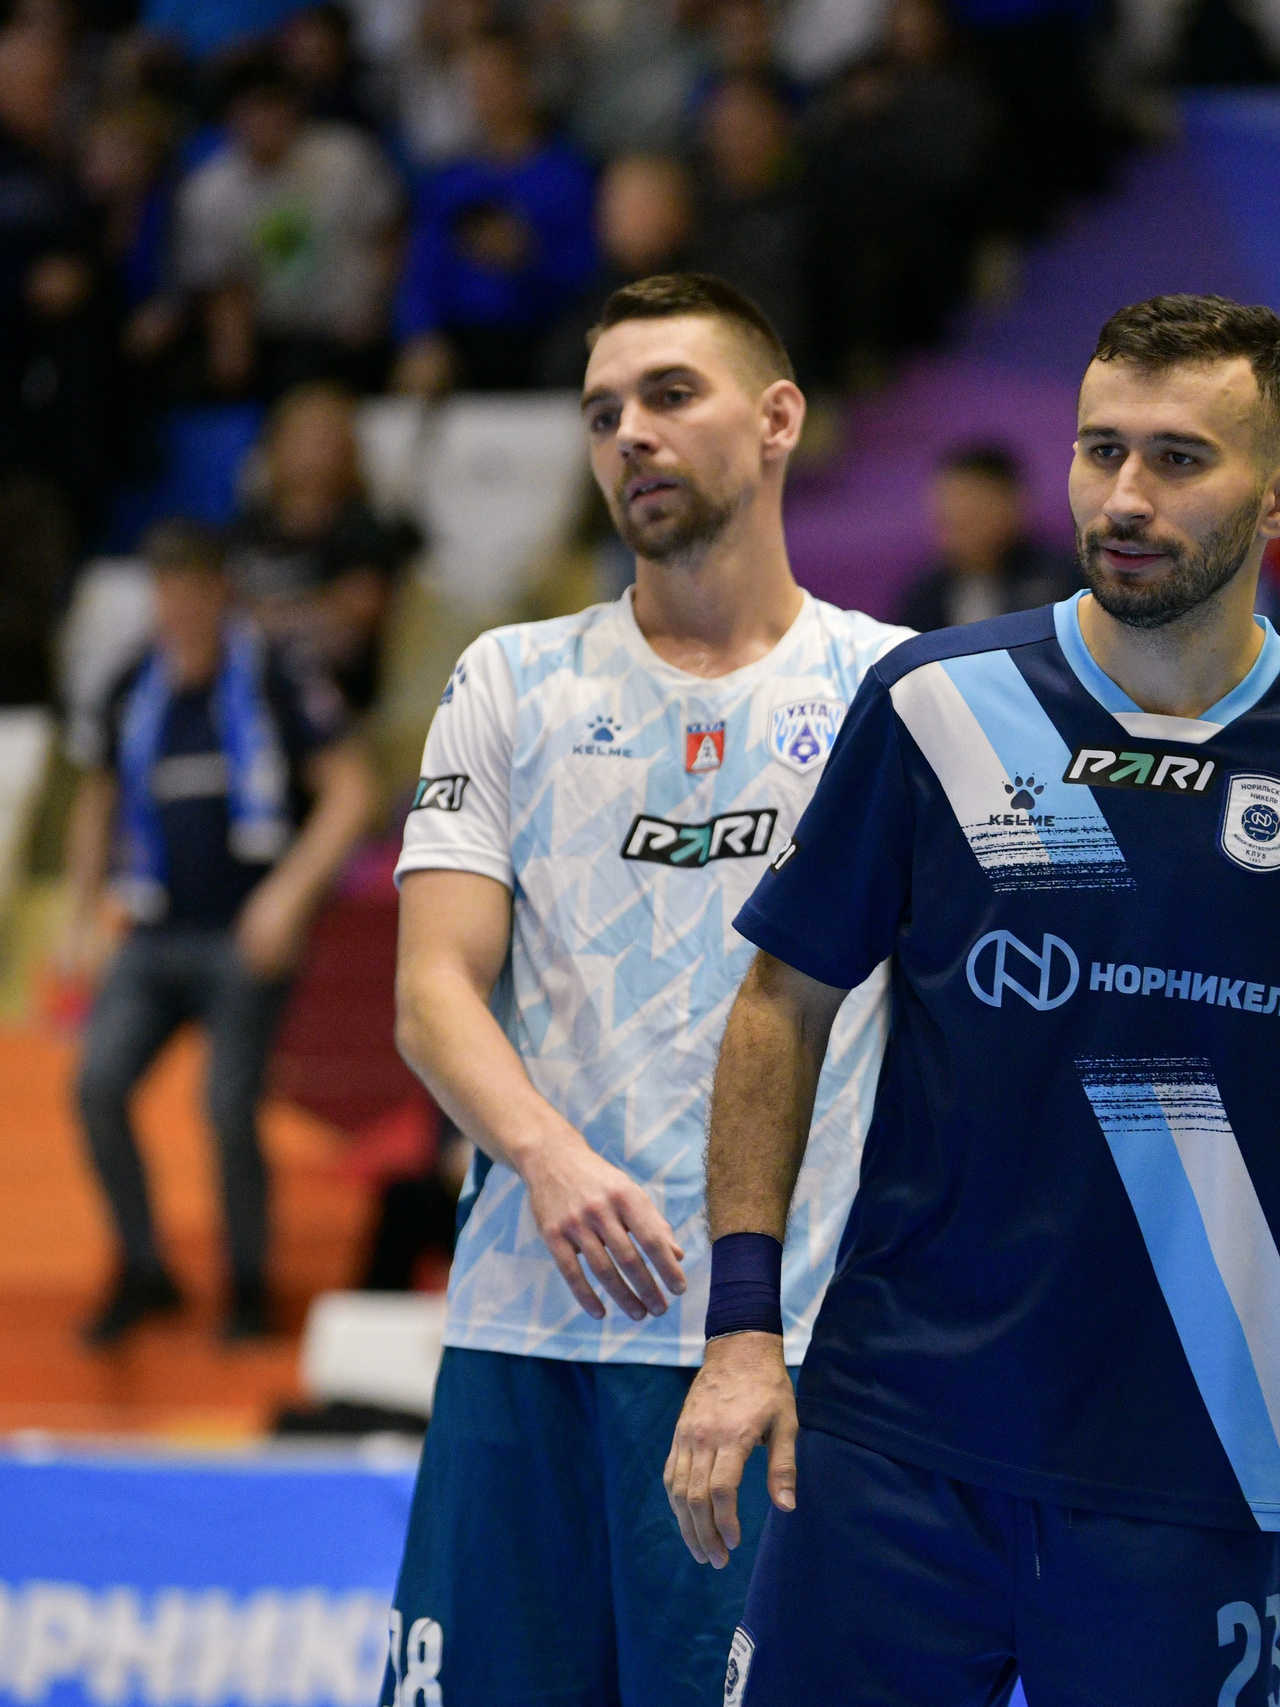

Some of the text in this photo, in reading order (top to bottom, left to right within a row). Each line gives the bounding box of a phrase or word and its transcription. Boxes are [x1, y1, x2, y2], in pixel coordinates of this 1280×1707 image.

[572, 744, 633, 758] KELME
[1069, 748, 1216, 791] PARI
[1250, 793, 1278, 804] НИКЕЛЬ
[989, 813, 1056, 828] KELME
[626, 808, 774, 863] PARI
[1246, 850, 1266, 859] КЛУБ
